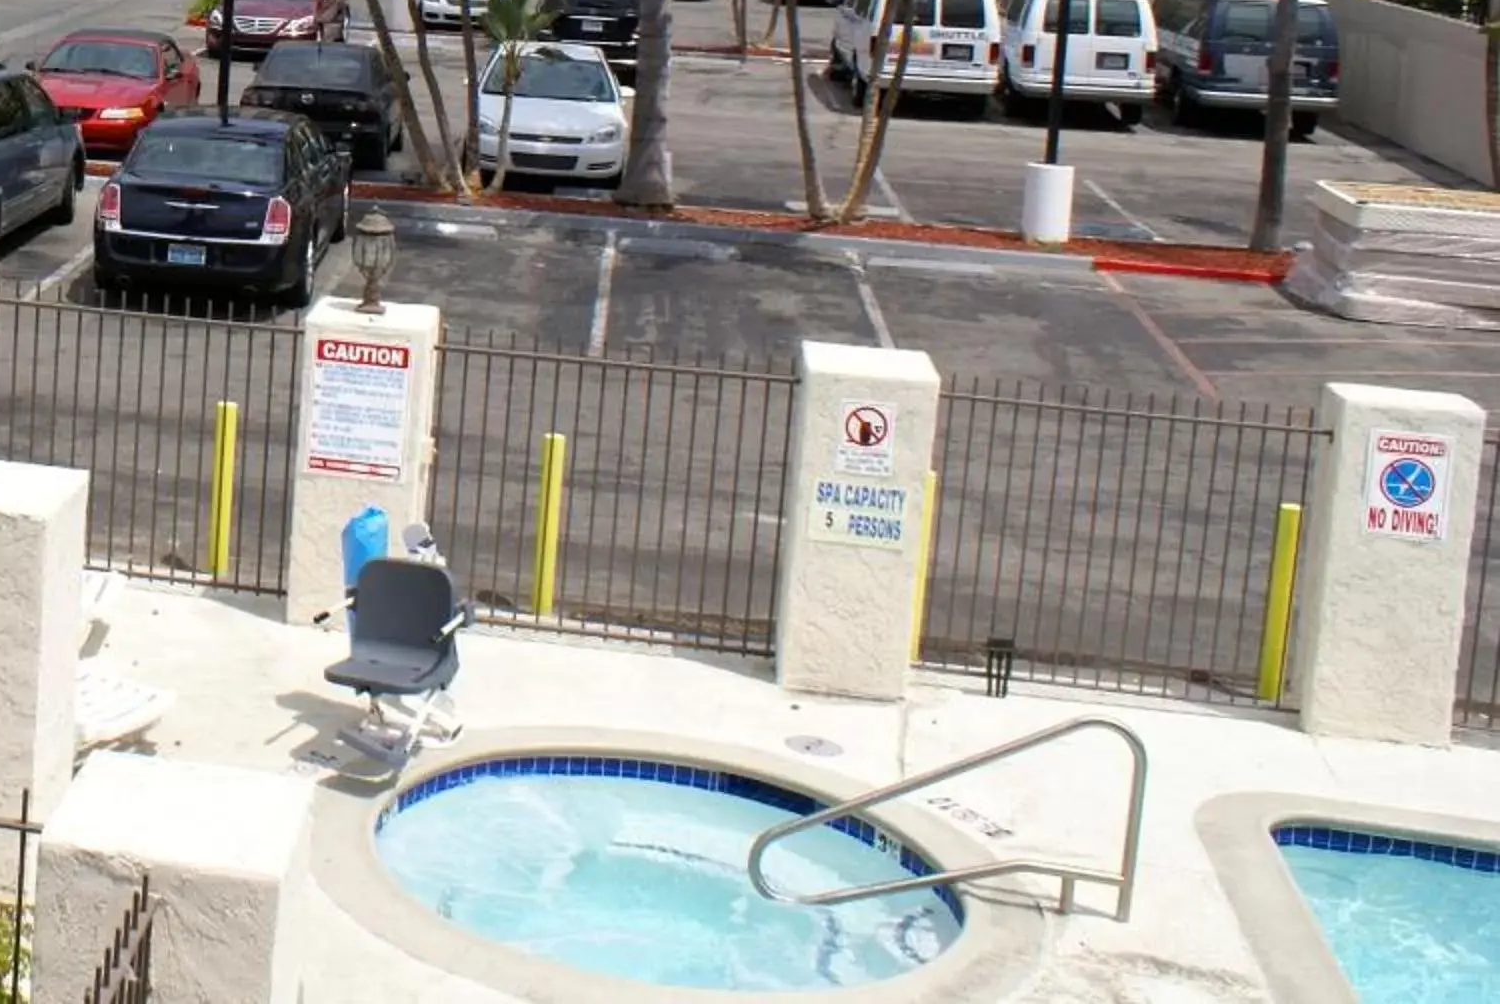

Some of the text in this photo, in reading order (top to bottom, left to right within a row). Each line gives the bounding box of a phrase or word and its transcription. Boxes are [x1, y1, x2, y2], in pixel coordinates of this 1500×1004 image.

[323, 341, 405, 366] CAUTION
[817, 482, 906, 513] SPA CAPACITY
[825, 511, 901, 540] 5 PERSONS
[1368, 507, 1438, 533] NO DIVING!
